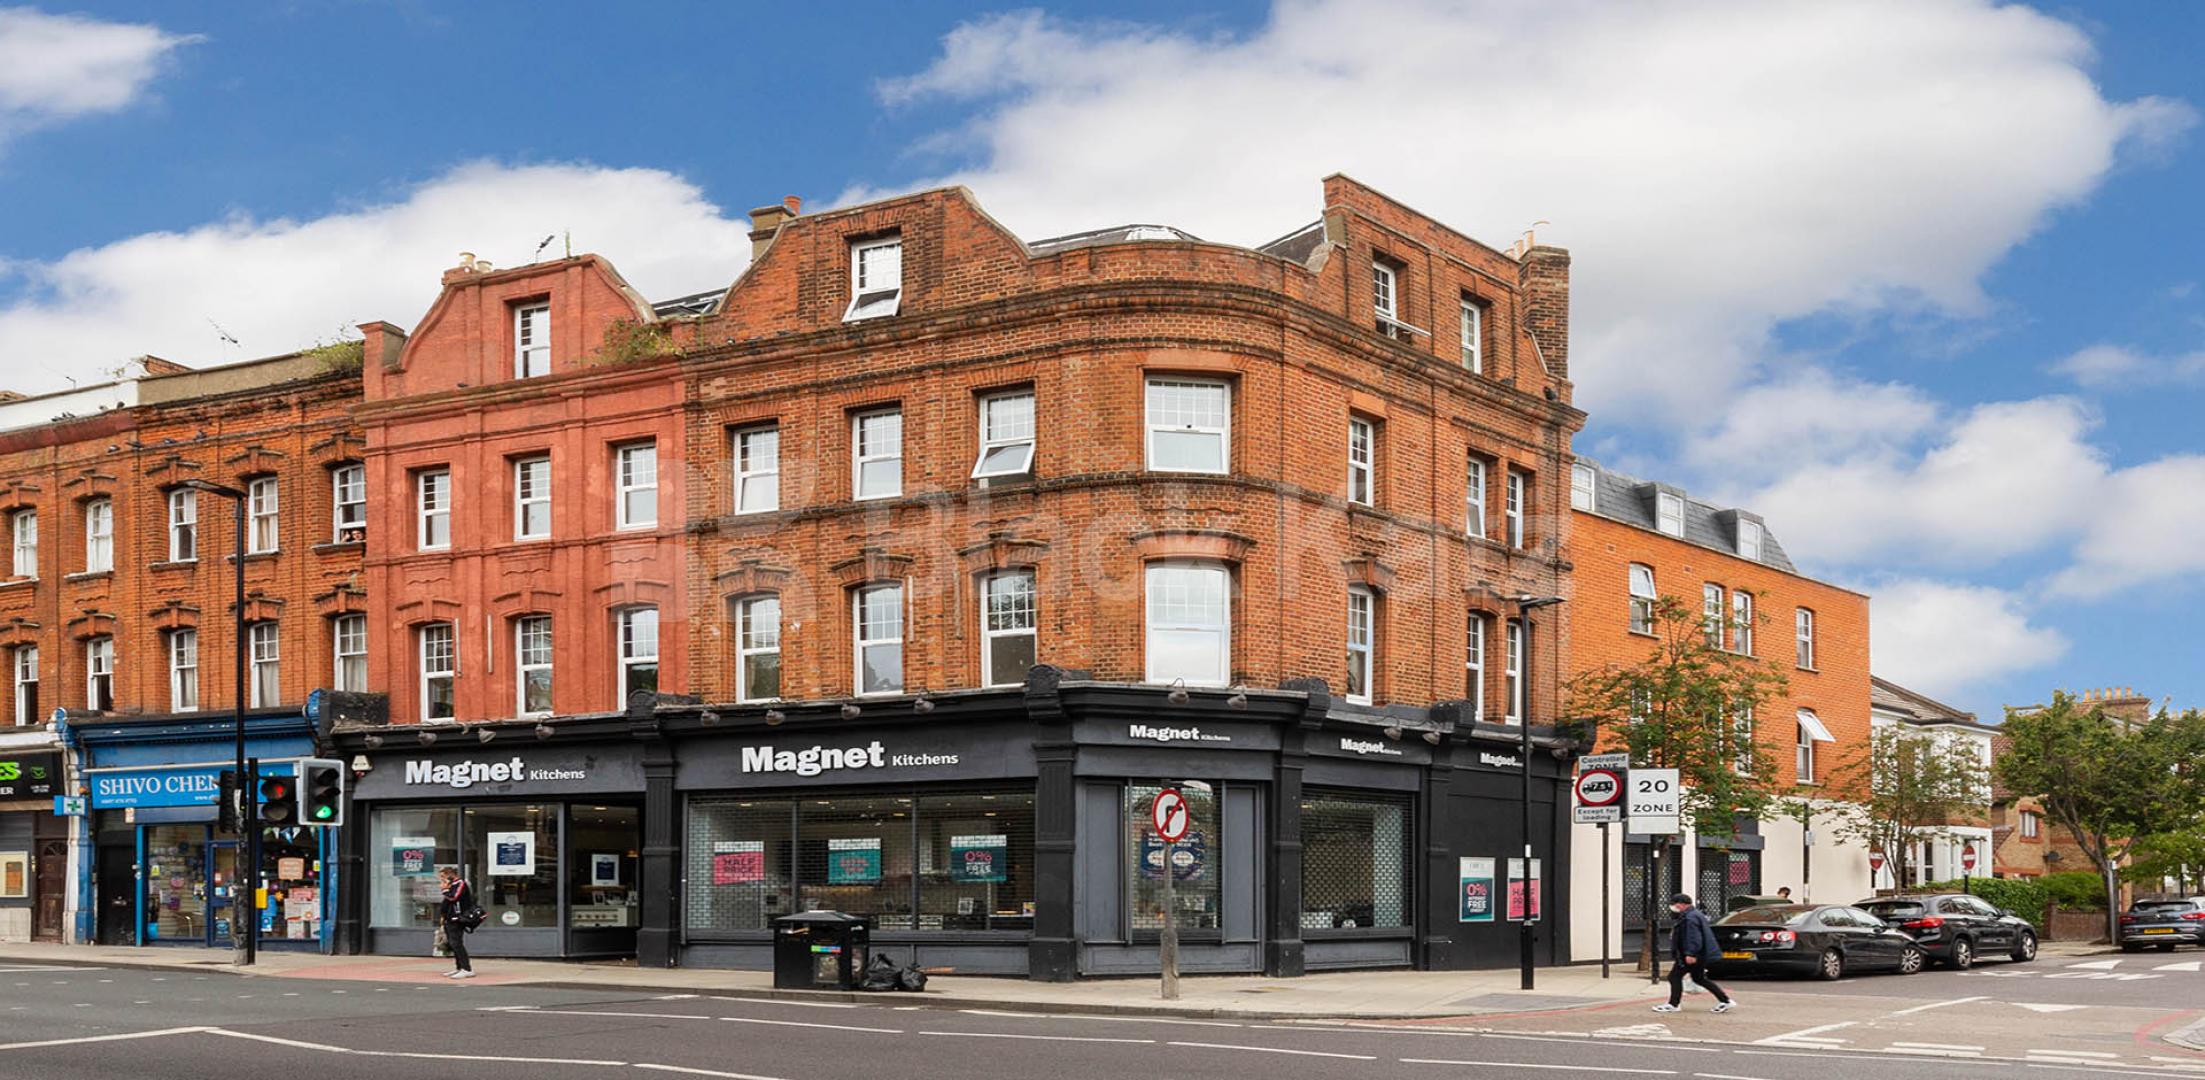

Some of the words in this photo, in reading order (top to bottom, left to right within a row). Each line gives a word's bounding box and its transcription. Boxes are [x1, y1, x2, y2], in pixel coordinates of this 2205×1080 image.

[1129, 724, 1200, 741] Magnet
[1340, 738, 1385, 755] Magnet
[742, 741, 885, 776] Magnet
[892, 753, 959, 767] Kitchens
[1581, 755, 1626, 765] Controlled
[405, 757, 525, 788] Magnet
[530, 769, 585, 781] Kitchens
[1588, 763, 1619, 771] ZONE
[99, 776, 161, 796] SHIVO
[1638, 780, 1670, 793] 20
[1577, 808, 1604, 817] Except
[1606, 807, 1618, 815] for
[1633, 803, 1673, 813] ZONE
[1582, 813, 1611, 821] loading
[403, 850, 425, 861] 0%
[964, 850, 993, 863] 0%
[1466, 883, 1488, 896] 0%
[1512, 887, 1536, 896] HAF
[1467, 900, 1487, 909] FREE
